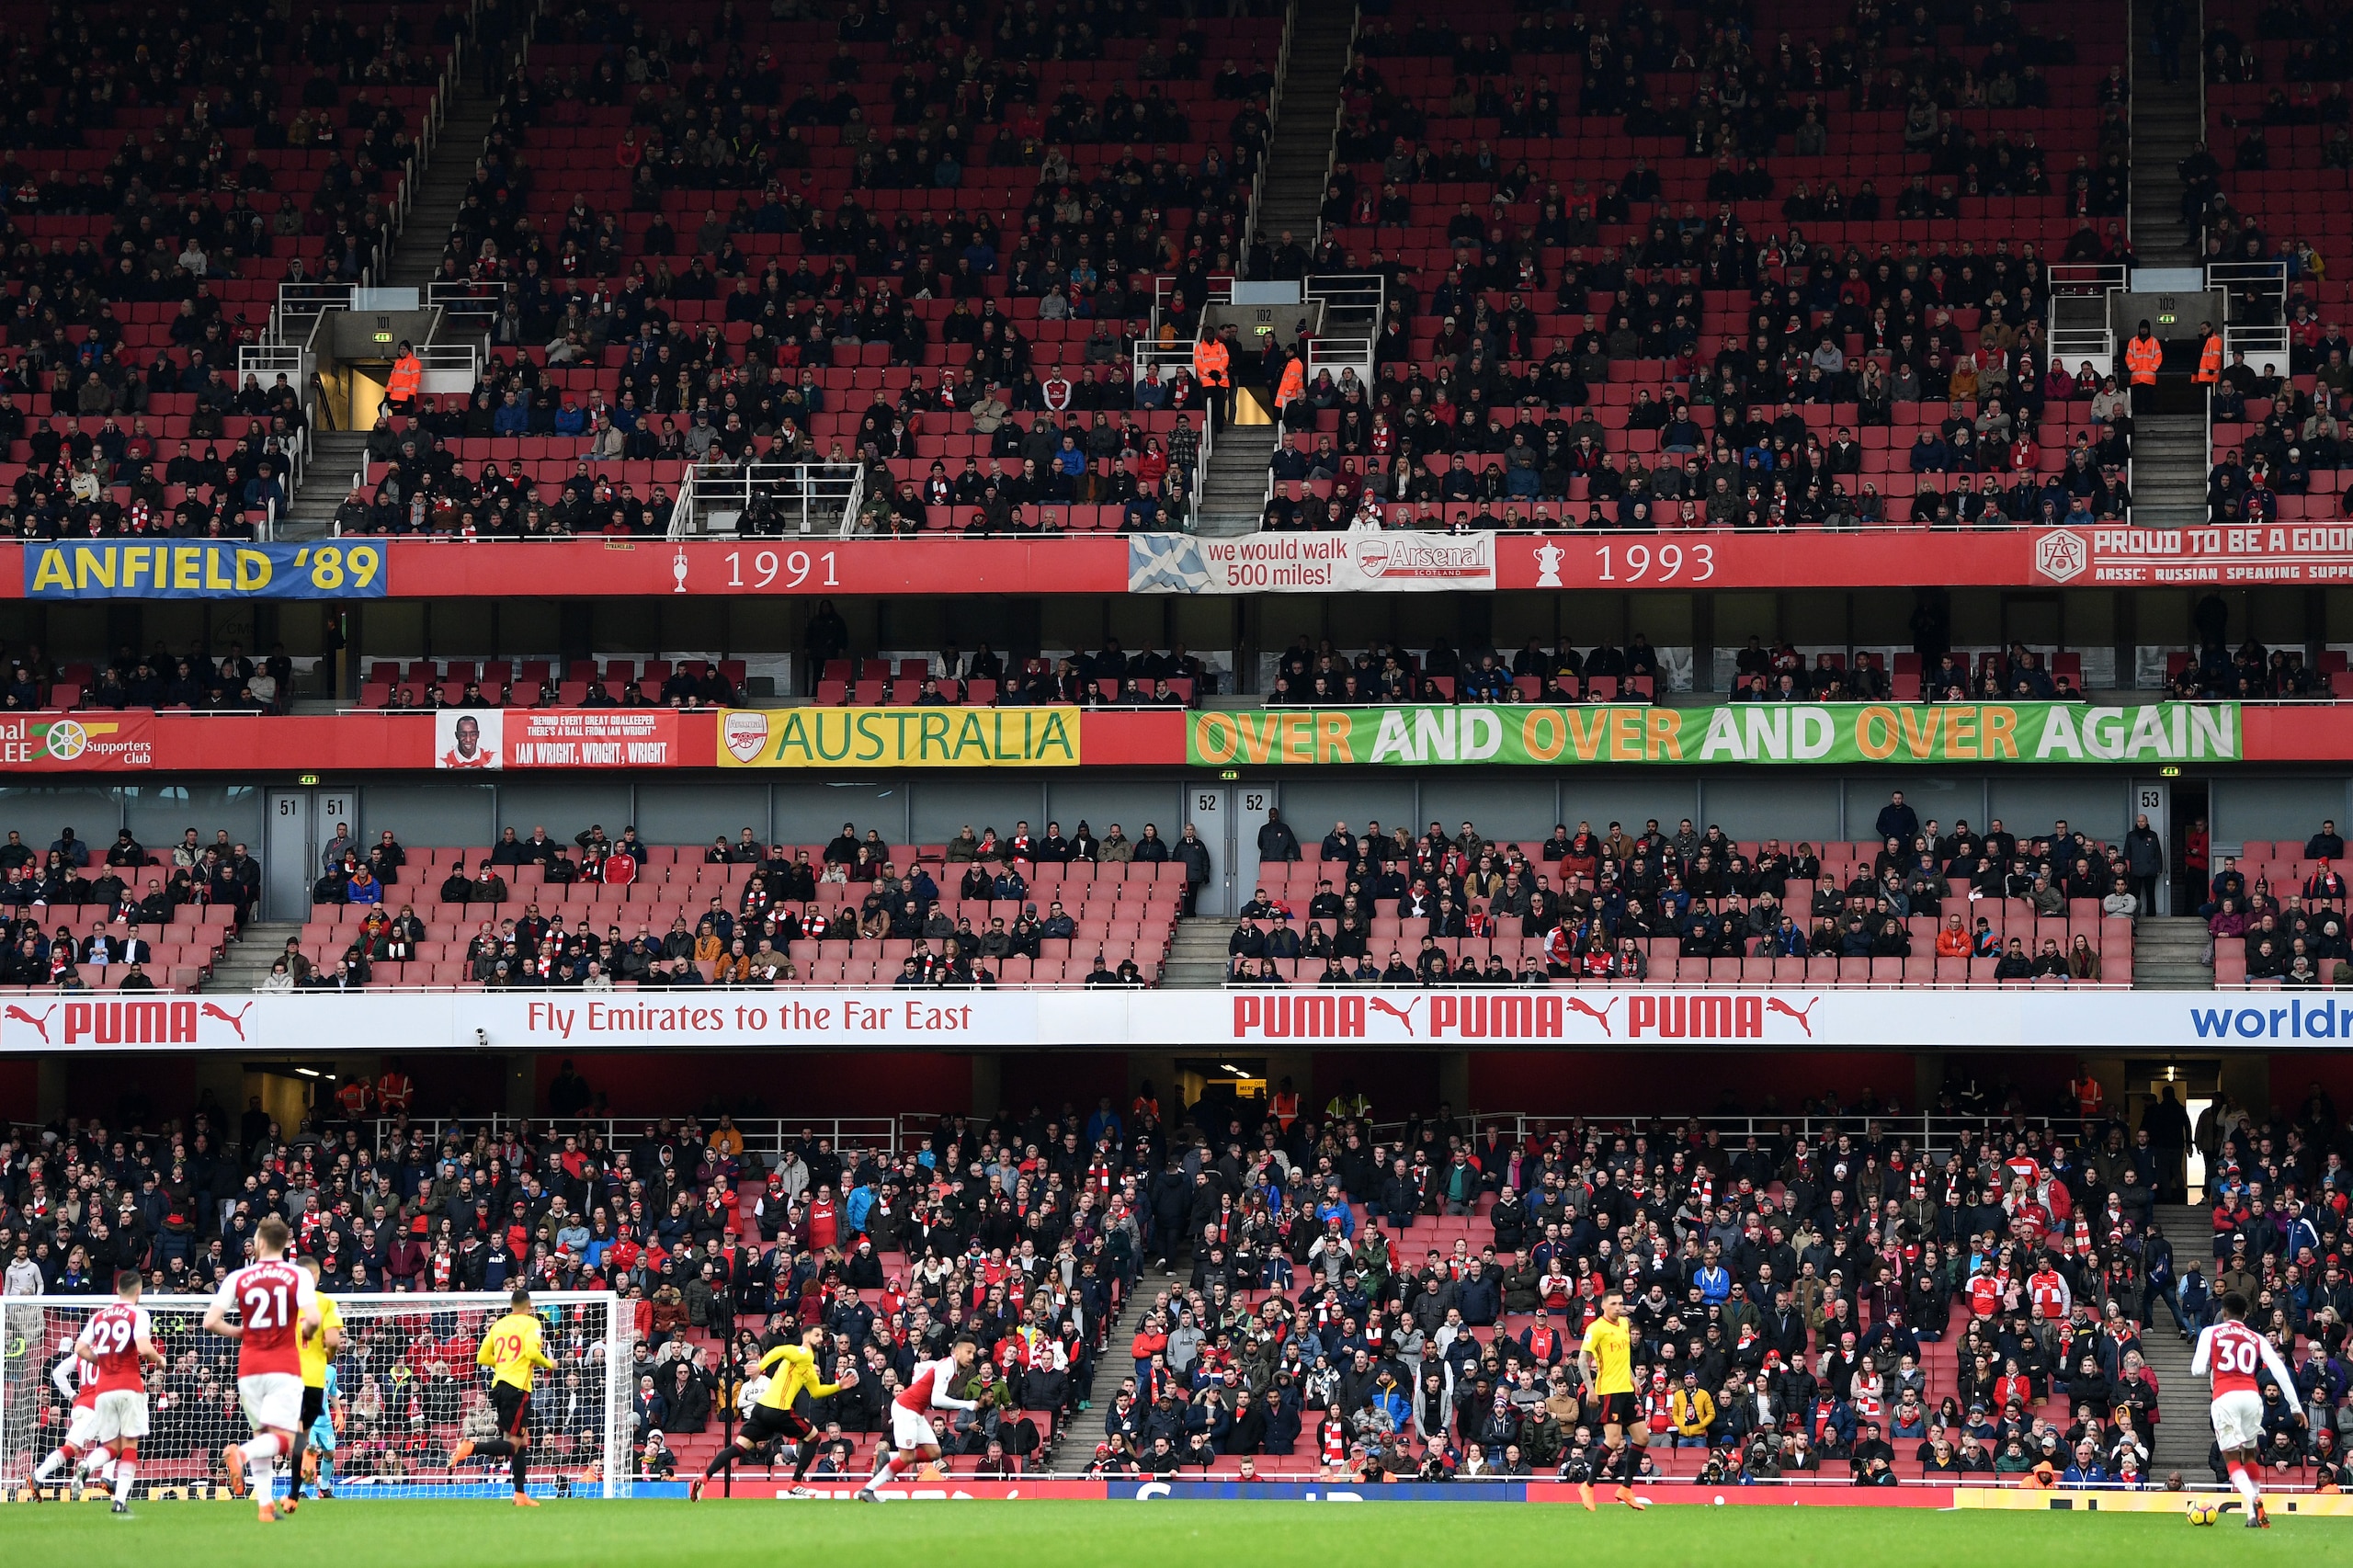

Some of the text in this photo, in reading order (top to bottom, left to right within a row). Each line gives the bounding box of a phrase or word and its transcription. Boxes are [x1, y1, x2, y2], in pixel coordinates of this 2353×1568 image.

[1256, 309, 1272, 322] 102
[2159, 297, 2175, 311] 103
[377, 316, 390, 329] 101
[1208, 537, 1348, 561] we would walk
[2094, 530, 2181, 553] PROUD
[2188, 529, 2221, 553] TO
[2227, 528, 2262, 552] BE
[2268, 528, 2286, 551] A
[1389, 540, 1484, 566] Arsenal
[1596, 544, 1714, 583] 1993
[32, 546, 273, 591] ANFIELD
[724, 551, 839, 588] 1991
[1226, 563, 1332, 586] 500 miles!
[2095, 567, 2146, 581] ARSSC:
[2155, 567, 2218, 581] RUSSIAN
[2226, 566, 2300, 580] SPEAKING
[527, 726, 555, 736] THERE'S
[558, 726, 563, 735] A
[565, 726, 584, 735] BALL
[585, 726, 606, 735] FROM
[608, 726, 620, 735] IAN
[561, 716, 584, 725] EVERY
[585, 716, 608, 725] GREAT
[610, 716, 654, 725] GOALKEEPER
[775, 712, 1074, 761] AUSTRALIA
[1195, 704, 2234, 764] OVER AND OVER AND OVER AGAIN
[0, 743, 32, 762] EE
[87, 741, 152, 755] Supporters
[123, 753, 151, 764] Club
[516, 743, 667, 765] IAN WRIGHT, WRIGHT, WRIGHT
[280, 800, 296, 815] 51
[327, 800, 343, 815] 51
[1199, 795, 1216, 811] 52
[1246, 794, 1263, 811] 52
[2142, 791, 2159, 808] 53
[64, 1001, 197, 1044] PUMA
[528, 1001, 972, 1039] Fly Emirates to the Far East
[1233, 995, 1365, 1038] PUMA
[1430, 995, 1563, 1038] PUMA
[1629, 995, 1762, 1038] PUMA
[241, 1267, 295, 1289] CHAMBERS
[244, 1285, 288, 1329] 21
[95, 1319, 131, 1355] 29
[494, 1334, 522, 1364] 29
[2216, 1338, 2257, 1375] 30
[79, 1358, 99, 1386] 10
